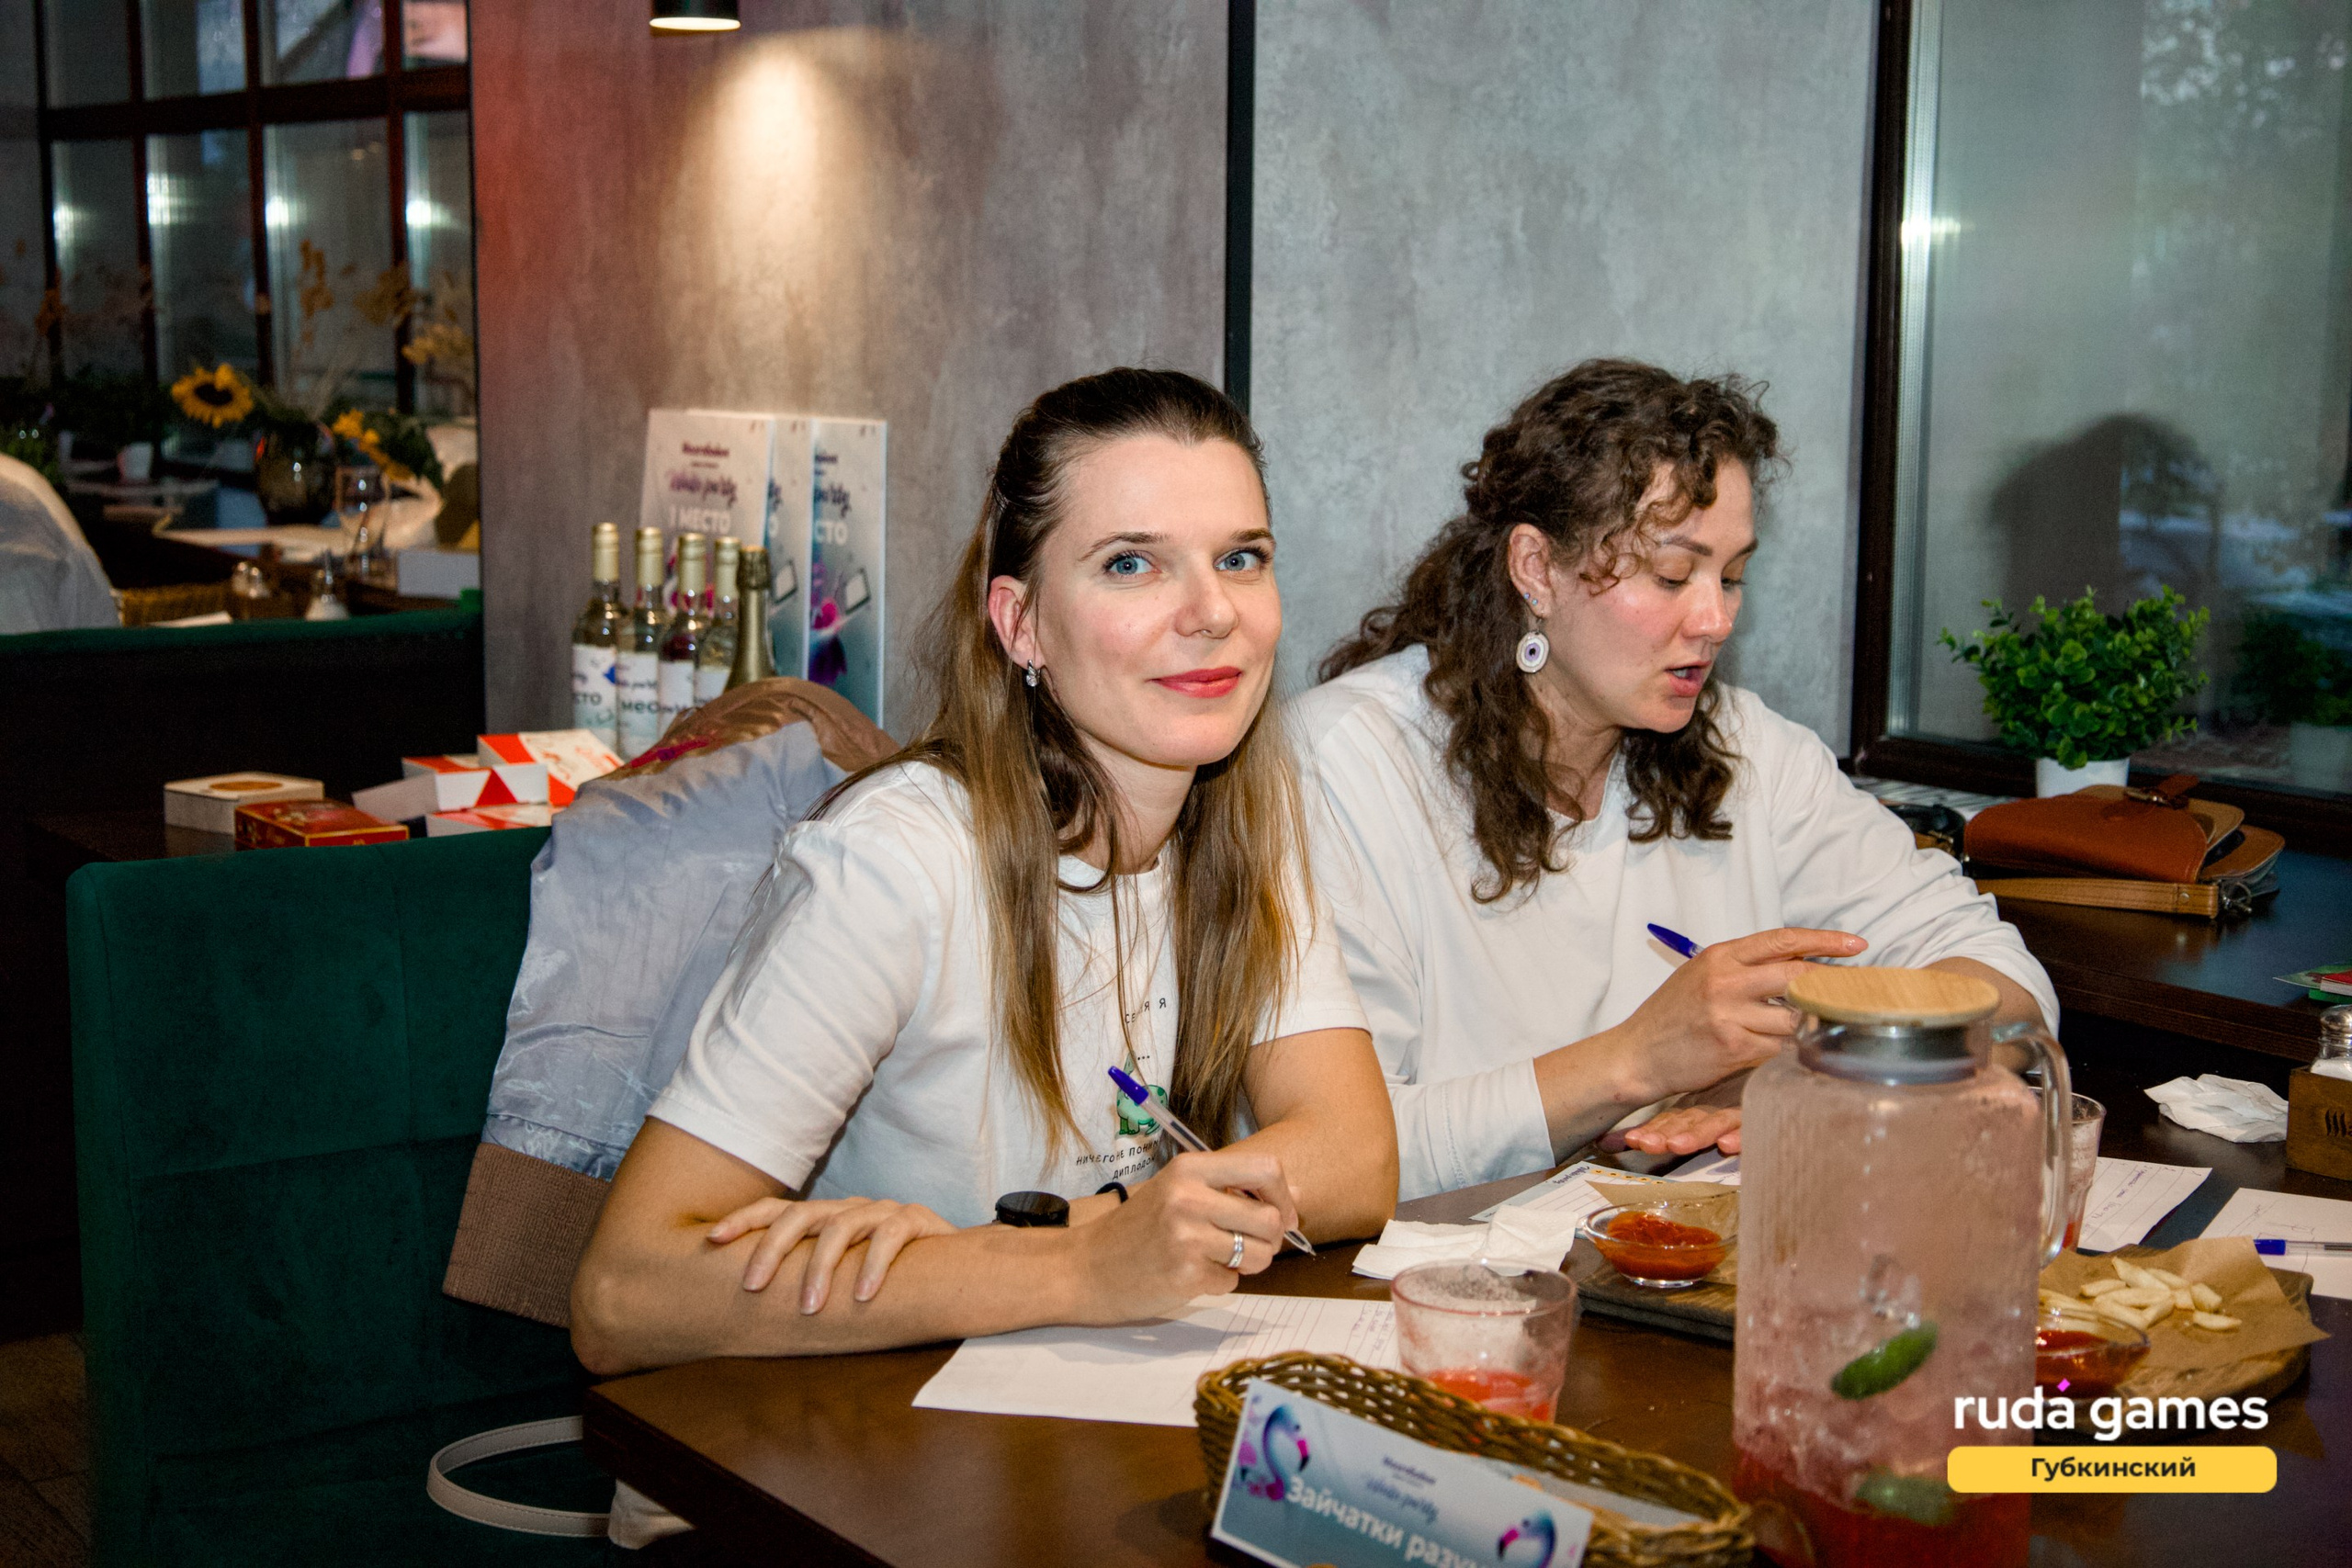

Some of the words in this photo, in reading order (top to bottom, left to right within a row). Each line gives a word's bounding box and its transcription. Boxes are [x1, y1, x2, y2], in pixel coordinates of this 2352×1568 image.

[815, 520, 848, 547] СТО
[1076, 1154, 1115, 1167] НИЧЕГО
[1287, 1474, 1405, 1550] Зайчатки
